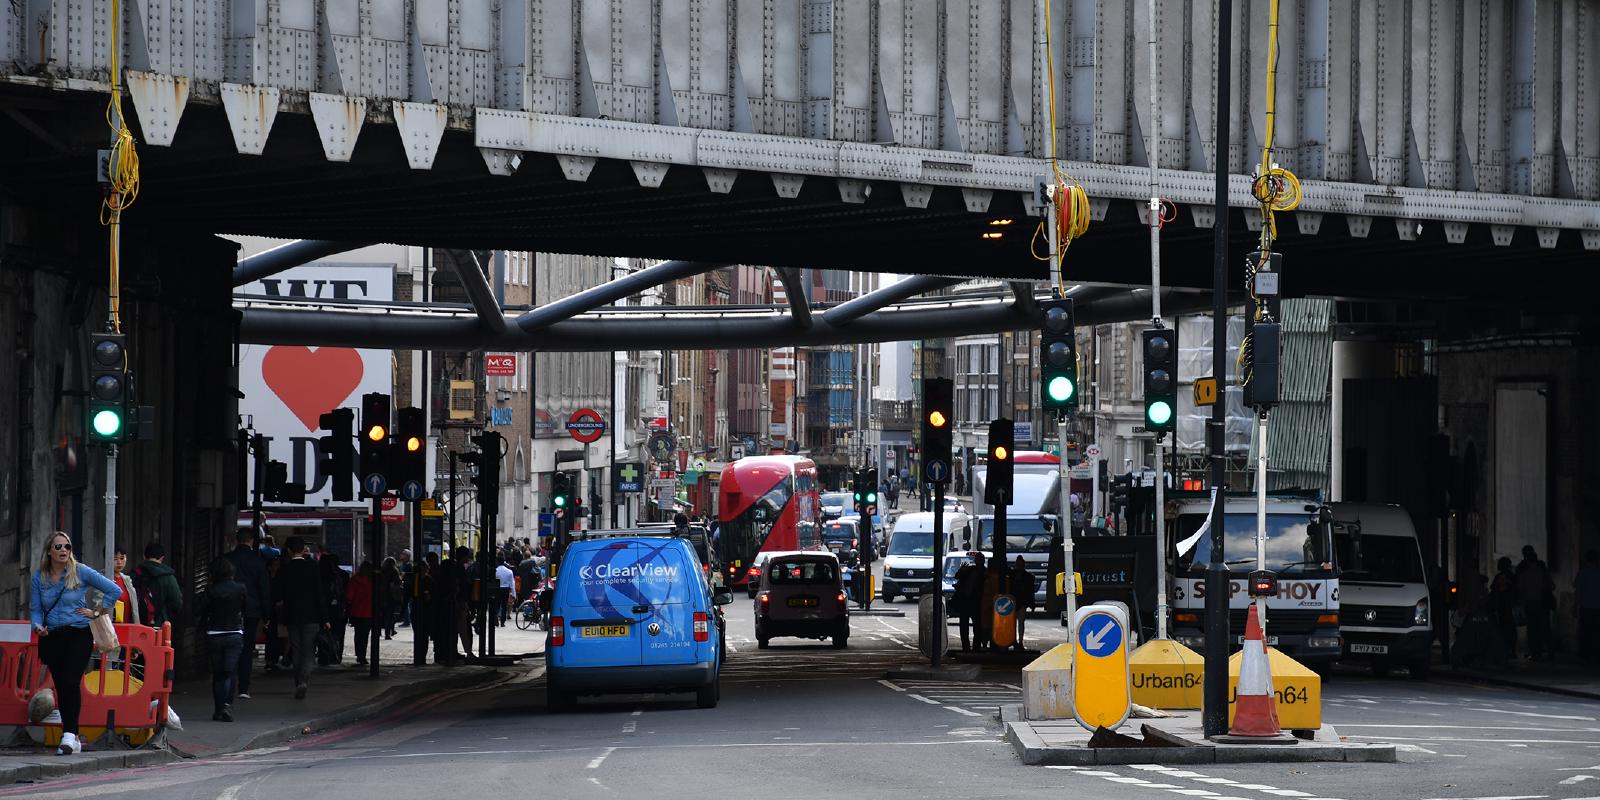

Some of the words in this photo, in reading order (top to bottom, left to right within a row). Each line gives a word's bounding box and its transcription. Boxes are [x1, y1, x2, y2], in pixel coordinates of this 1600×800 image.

[595, 564, 677, 578] ClearView
[596, 577, 626, 586] complete
[628, 576, 654, 585] security
[1193, 581, 1321, 600] SP-HOY
[1132, 672, 1201, 689] Urban64
